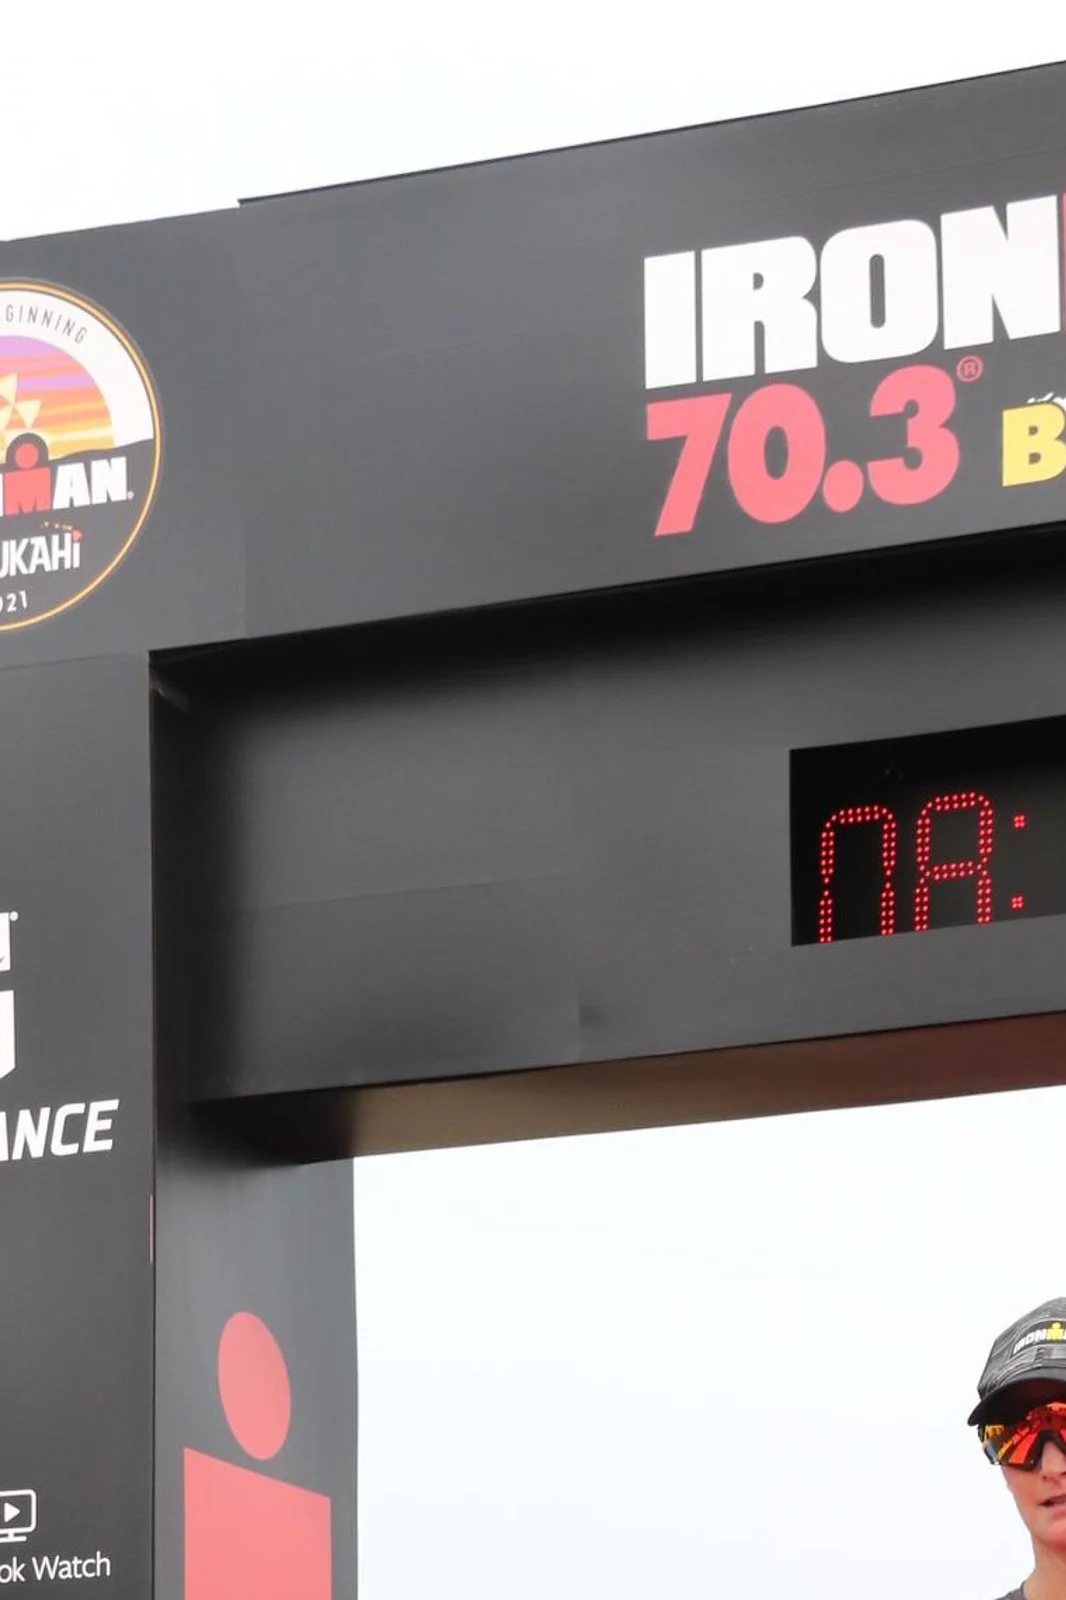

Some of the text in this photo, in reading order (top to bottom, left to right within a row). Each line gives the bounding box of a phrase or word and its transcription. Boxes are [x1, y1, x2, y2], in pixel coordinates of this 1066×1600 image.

[0, 442, 127, 516] MAN
[646, 363, 961, 537] 70.3
[0, 1551, 111, 1584] ok Watch
